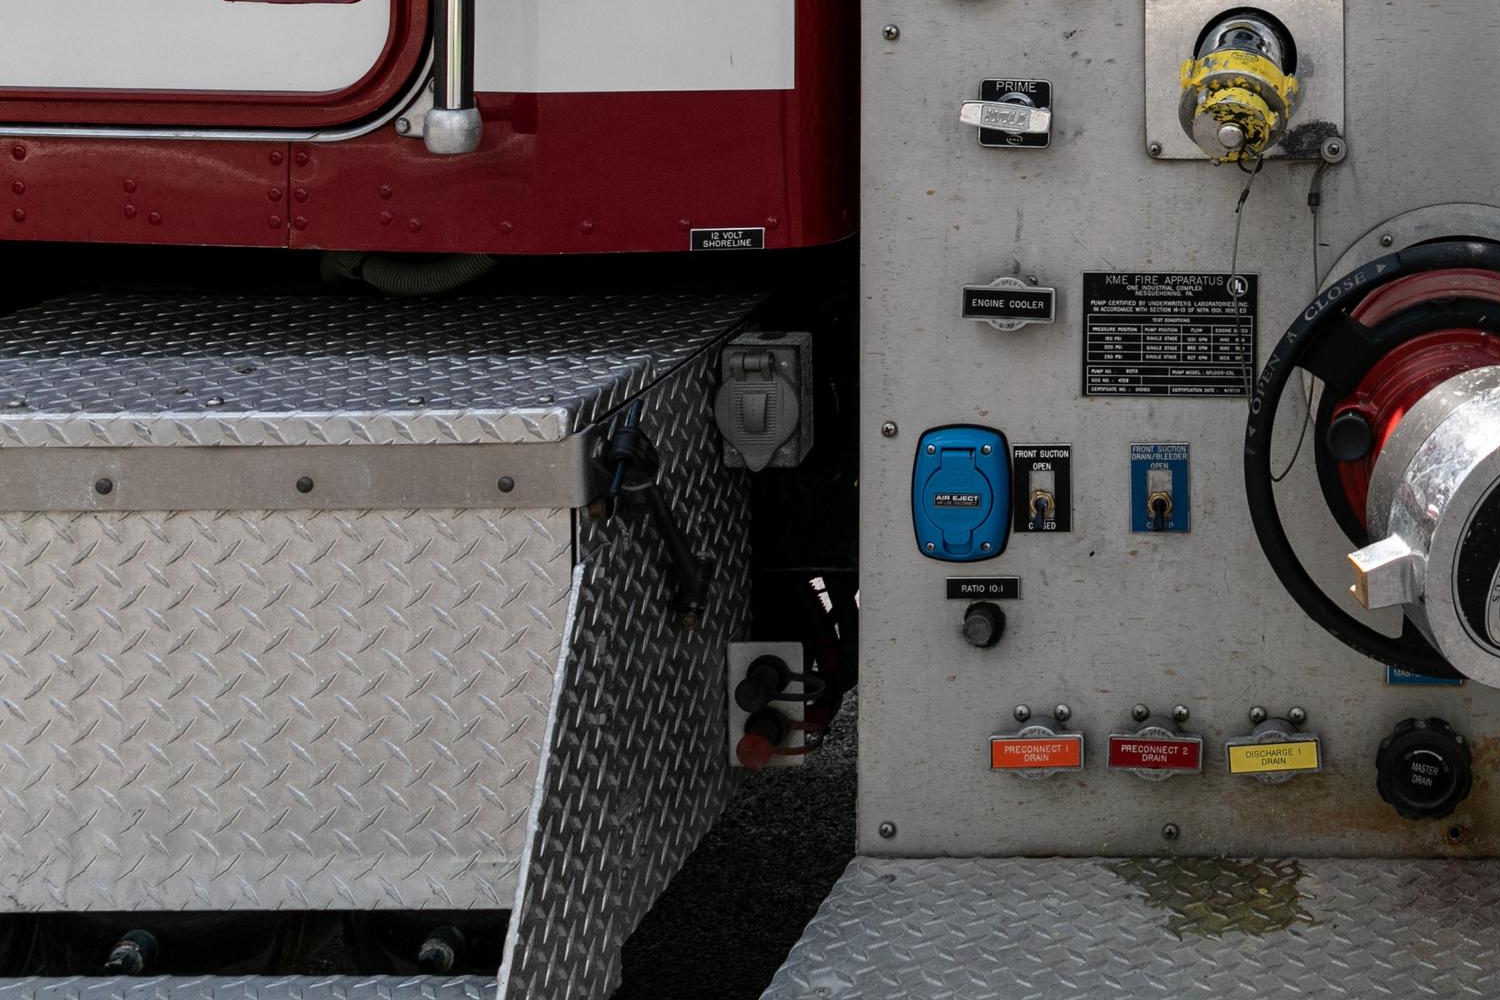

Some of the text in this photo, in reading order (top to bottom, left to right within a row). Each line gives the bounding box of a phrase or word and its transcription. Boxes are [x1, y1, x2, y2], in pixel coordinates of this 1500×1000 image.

[996, 82, 1037, 92] PRIME
[722, 231, 743, 239] VOLT
[703, 239, 752, 247] SHORELINE
[1105, 275, 1224, 285] KME FIRE APPARATUS
[1304, 272, 1367, 321] CLOSE
[972, 298, 1044, 309] ENGINE COOLER
[1253, 355, 1281, 415] OPEN
[1015, 450, 1069, 458] FRONT SUCTION
[961, 585, 985, 593] RATIO
[1004, 744, 1062, 753] PRECONNECT
[1120, 744, 1189, 755] PRECONNECT 2
[1246, 748, 1294, 758] DISCHARGE
[1024, 753, 1049, 761] DRAIN
[1141, 753, 1167, 762] DRAIN
[1261, 757, 1286, 766] DRAIN
[1412, 761, 1439, 776] MASTER
[1411, 774, 1433, 787] DRAIN
